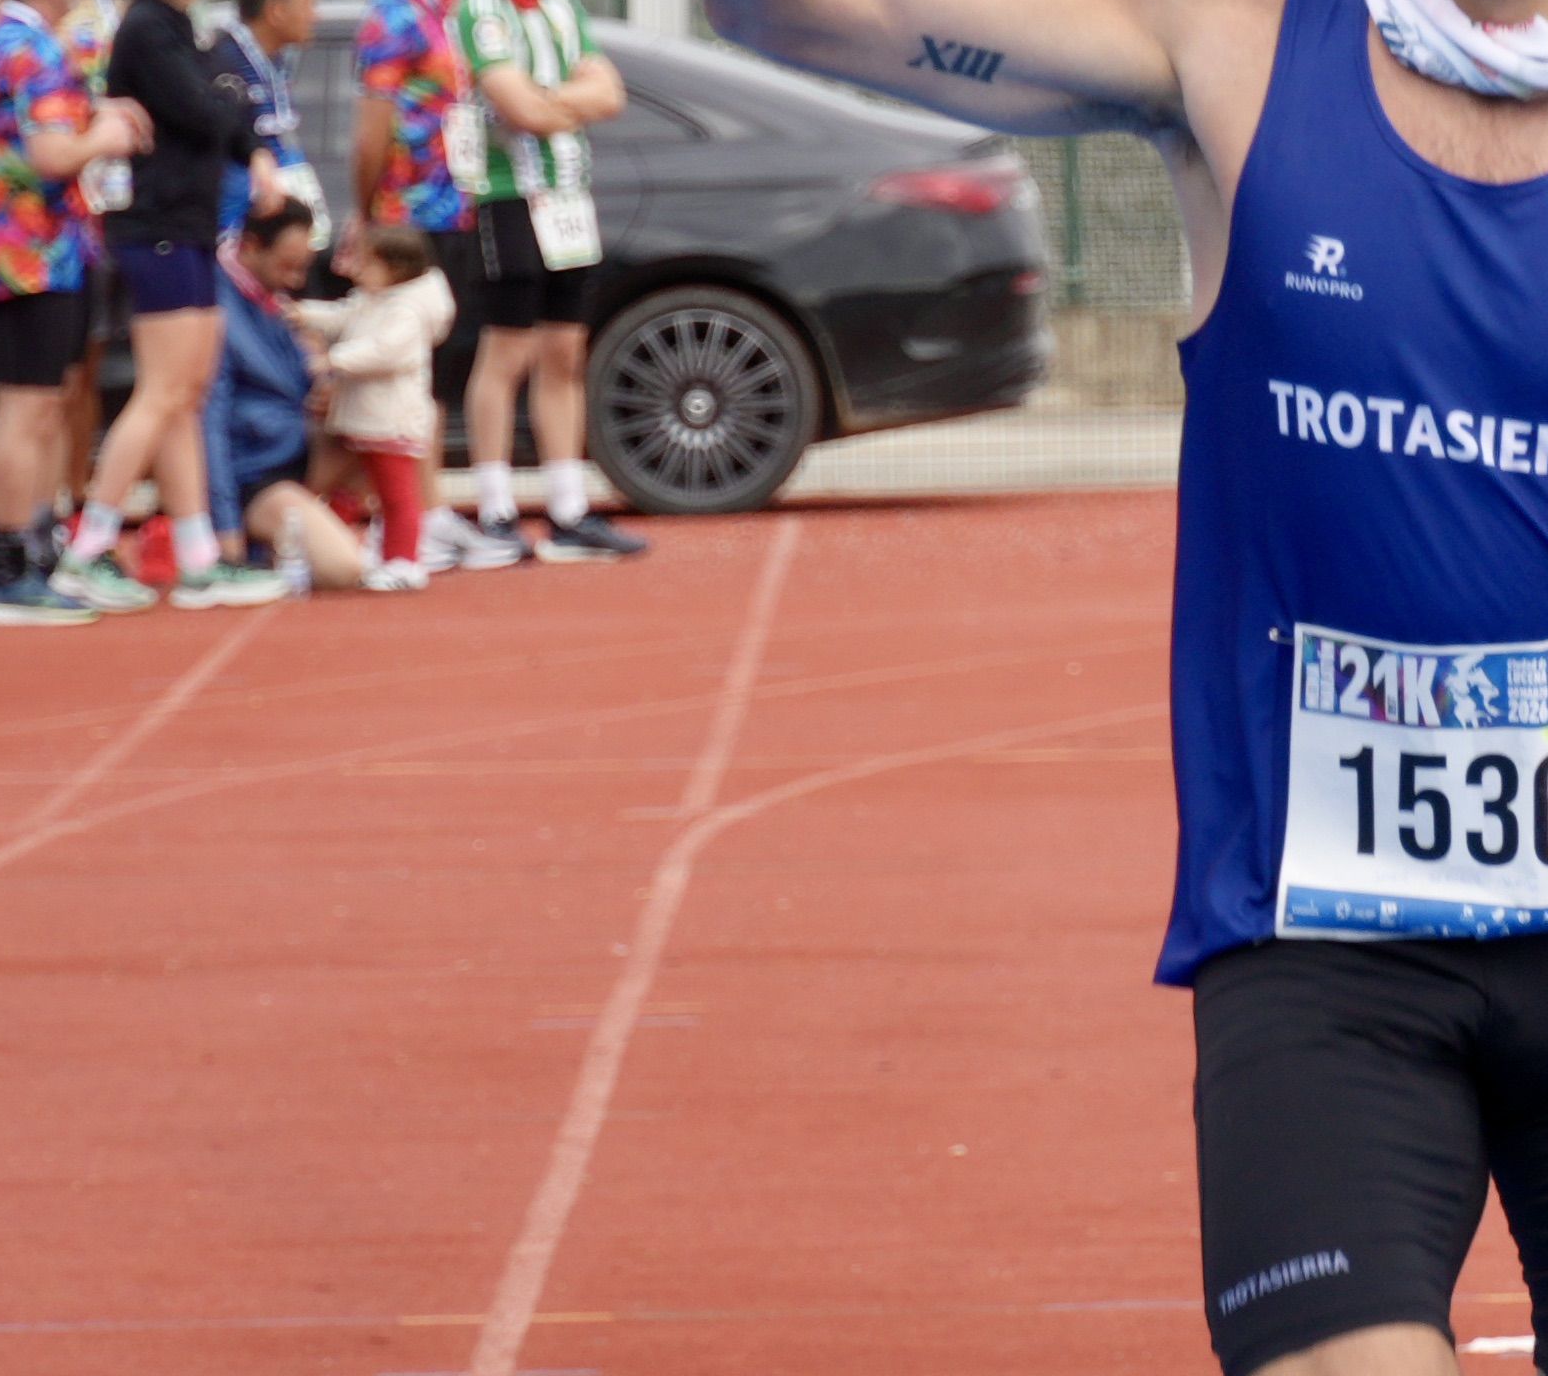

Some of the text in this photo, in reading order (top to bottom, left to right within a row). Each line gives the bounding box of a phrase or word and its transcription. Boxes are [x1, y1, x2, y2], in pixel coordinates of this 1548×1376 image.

[907, 34, 1005, 82] XIII
[1339, 643, 1442, 728] 21K
[1219, 1248, 1350, 1318] TROTASIERRA
